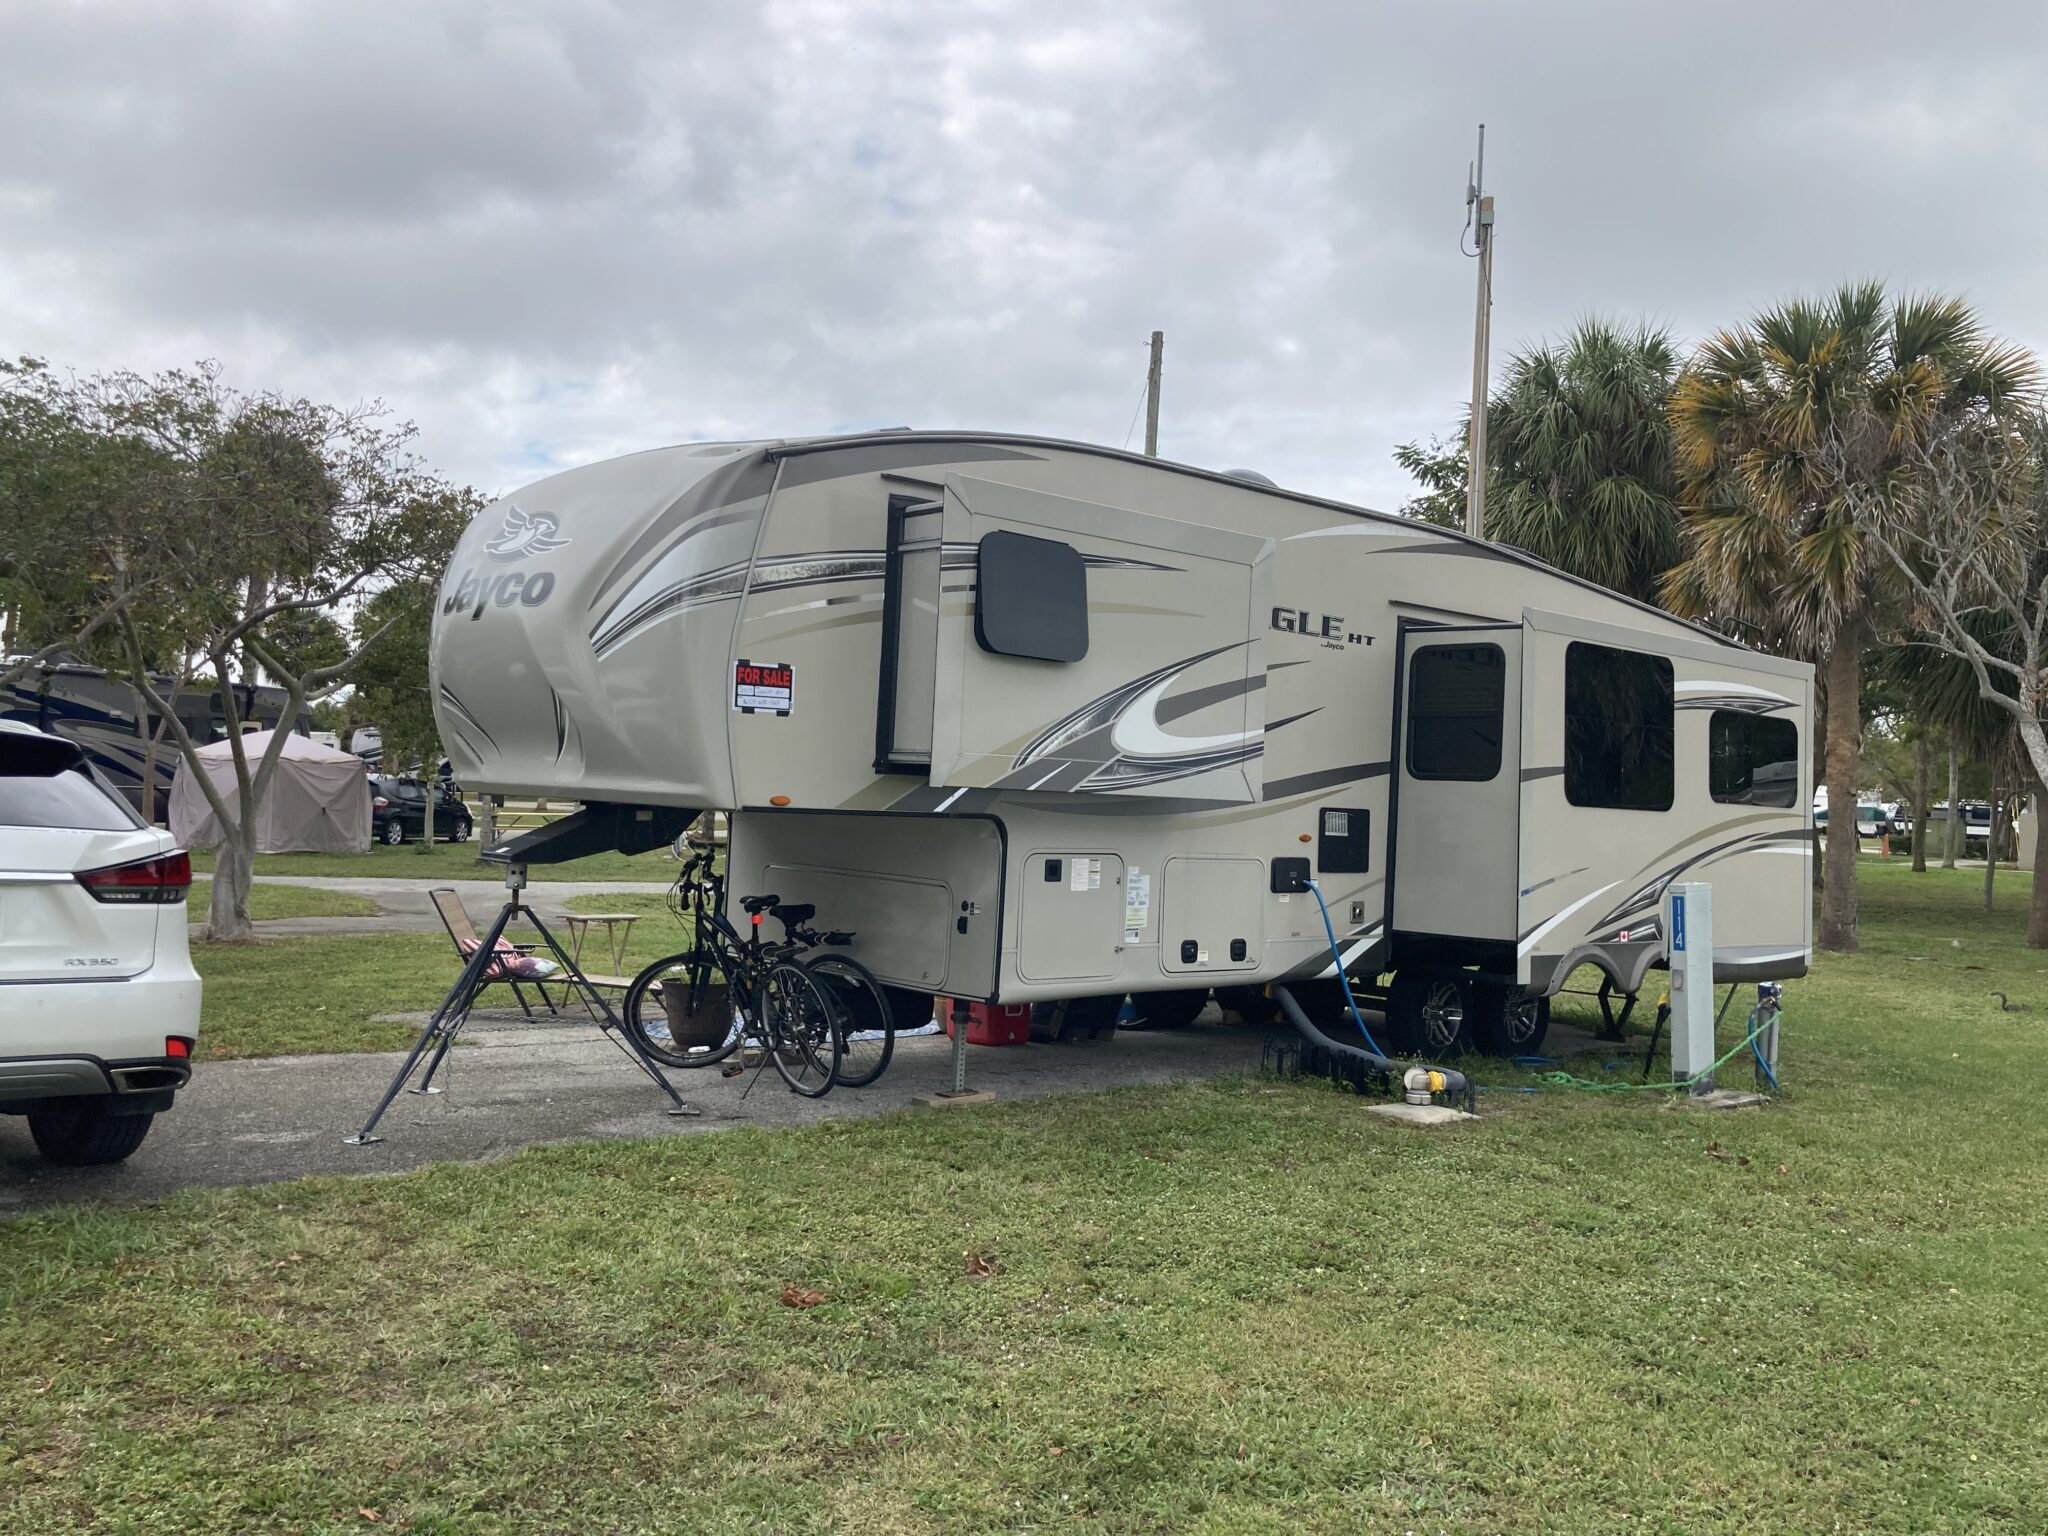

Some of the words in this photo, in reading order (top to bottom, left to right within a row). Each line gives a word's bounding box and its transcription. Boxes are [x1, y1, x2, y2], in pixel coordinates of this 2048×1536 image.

[443, 567, 556, 621] Jayco
[1270, 605, 1345, 641] GLE
[1348, 632, 1377, 647] HT
[1325, 640, 1345, 651] Jayco
[737, 666, 761, 685] FOR
[763, 669, 791, 688] SALE
[88, 958, 119, 967] 350
